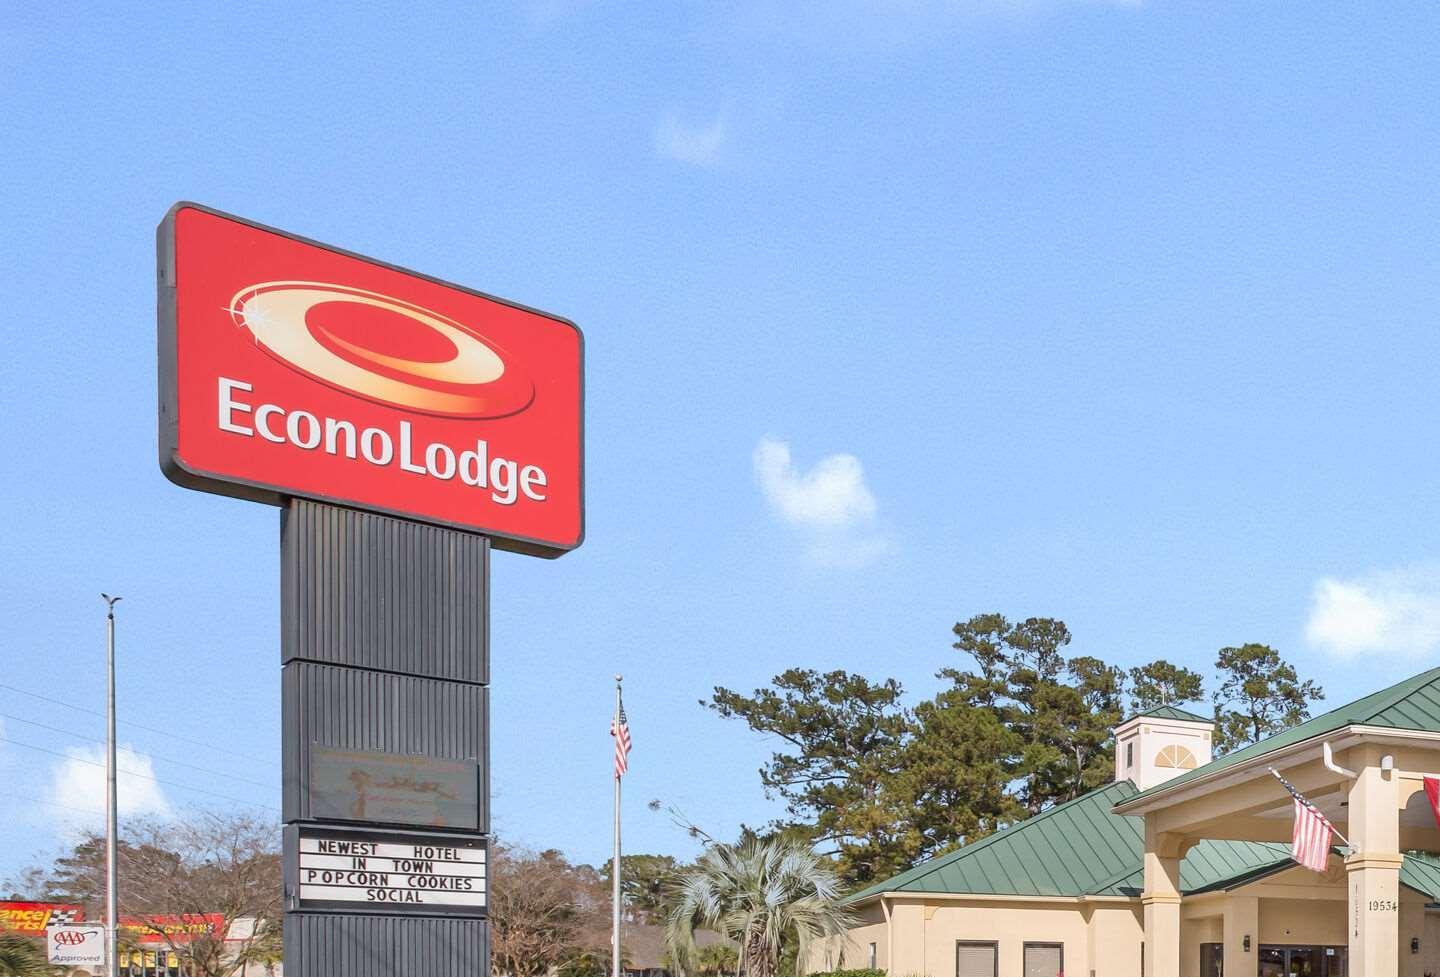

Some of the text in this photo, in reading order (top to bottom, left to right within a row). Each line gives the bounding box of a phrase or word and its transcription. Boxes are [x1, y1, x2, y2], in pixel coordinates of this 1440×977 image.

[217, 376, 548, 505] EconoLodge
[318, 840, 462, 860] NEWEST HOTEL
[352, 857, 433, 873] IN TOWN
[407, 875, 473, 890] COOKIES
[366, 889, 424, 903] SOCIAL
[56, 931, 84, 945] AAA
[52, 954, 101, 963] Approved
